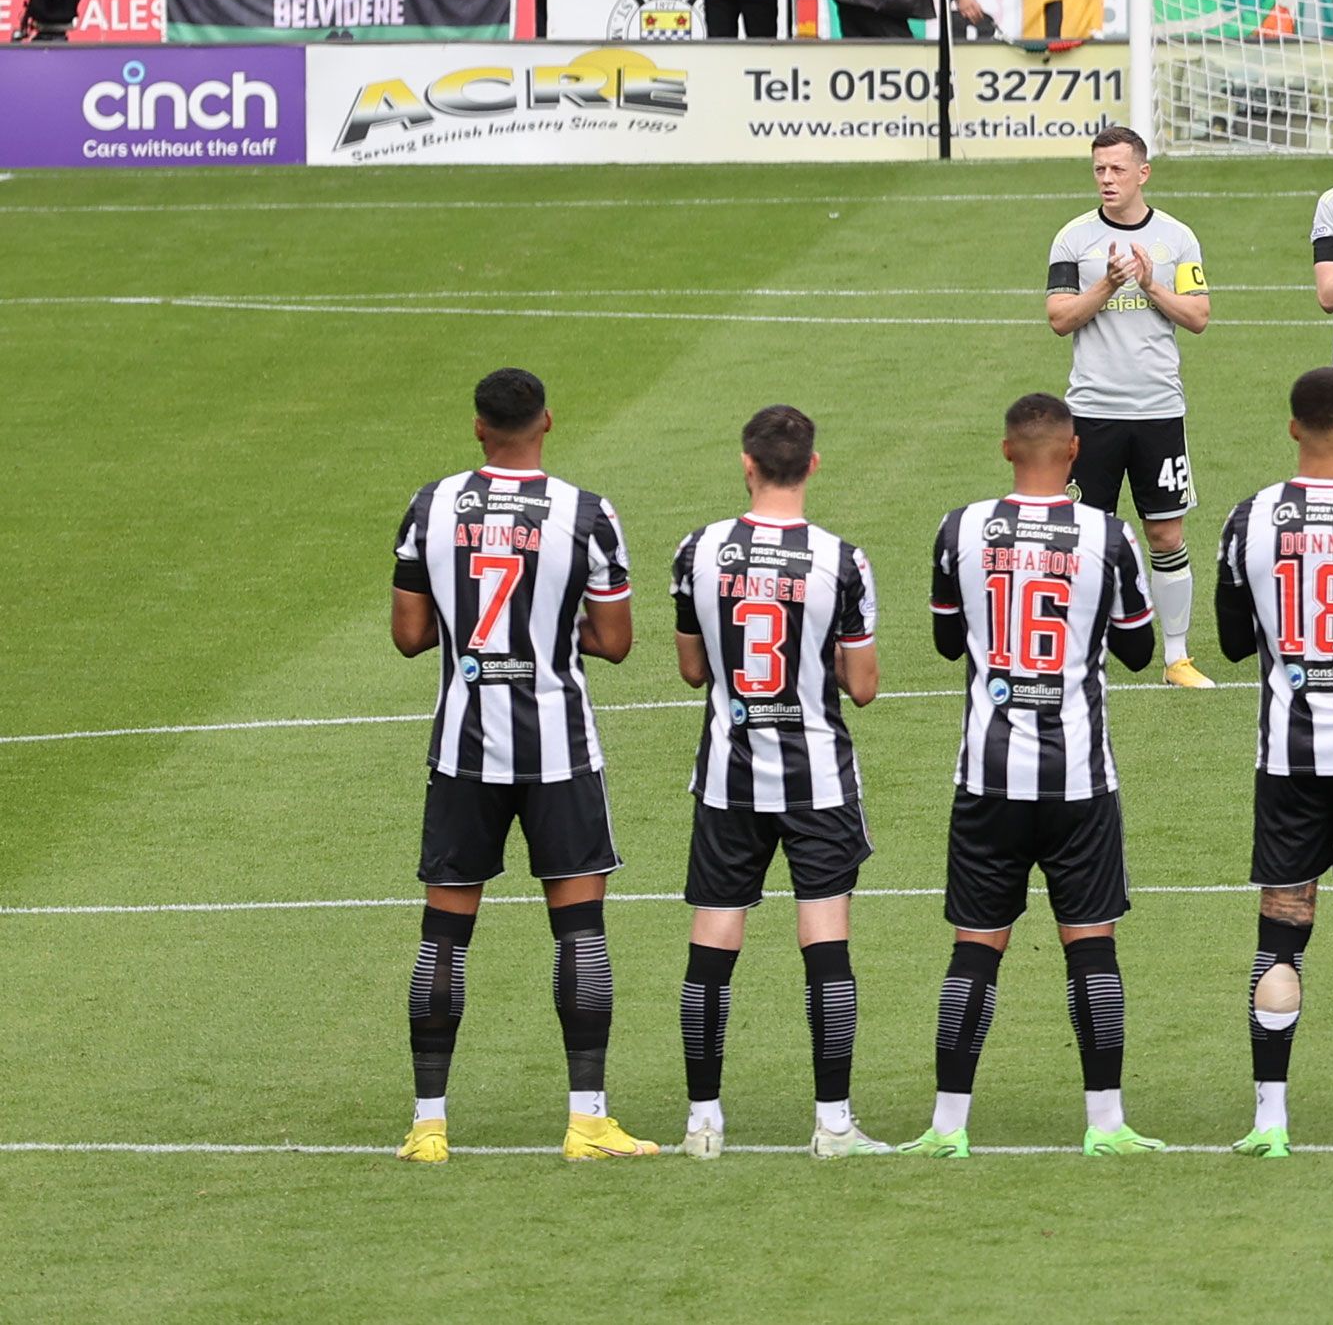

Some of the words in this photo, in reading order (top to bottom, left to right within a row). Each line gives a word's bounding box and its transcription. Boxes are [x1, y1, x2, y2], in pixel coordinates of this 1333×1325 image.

[744, 67, 811, 102] Tel:
[975, 68, 1122, 103] 327711
[82, 60, 278, 132] cinch
[332, 65, 689, 154] ACRE
[82, 139, 128, 158] Cars
[131, 138, 203, 158] without
[207, 138, 238, 157] the
[241, 137, 278, 156] faff
[351, 140, 417, 164] Serving
[422, 128, 482, 149] British
[488, 119, 563, 137] Industry
[569, 115, 618, 132] Since
[627, 118, 678, 136] 1989
[1192, 268, 1204, 286] C
[1157, 454, 1189, 492] 42
[487, 494, 511, 504] FIRST
[512, 496, 551, 508] VEHICLE
[487, 501, 524, 513] LEASING
[1305, 505, 1330, 516] FIRST
[454, 523, 540, 552] AYUNGA
[1016, 522, 1041, 533] FIRST
[1042, 524, 1079, 536] VEHICLE
[1016, 531, 1053, 540] LEASING
[750, 547, 775, 557] FIRST
[776, 549, 813, 561] VEHICLE
[750, 556, 788, 567] LEASING
[981, 547, 1080, 576] ERHAHON
[719, 573, 806, 603] TANSER
[468, 552, 524, 650] 7
[985, 573, 1072, 675] 16
[732, 599, 787, 696] 3
[481, 659, 534, 672] consilium
[1012, 683, 1061, 695] consilium
[748, 703, 801, 715] consilium
